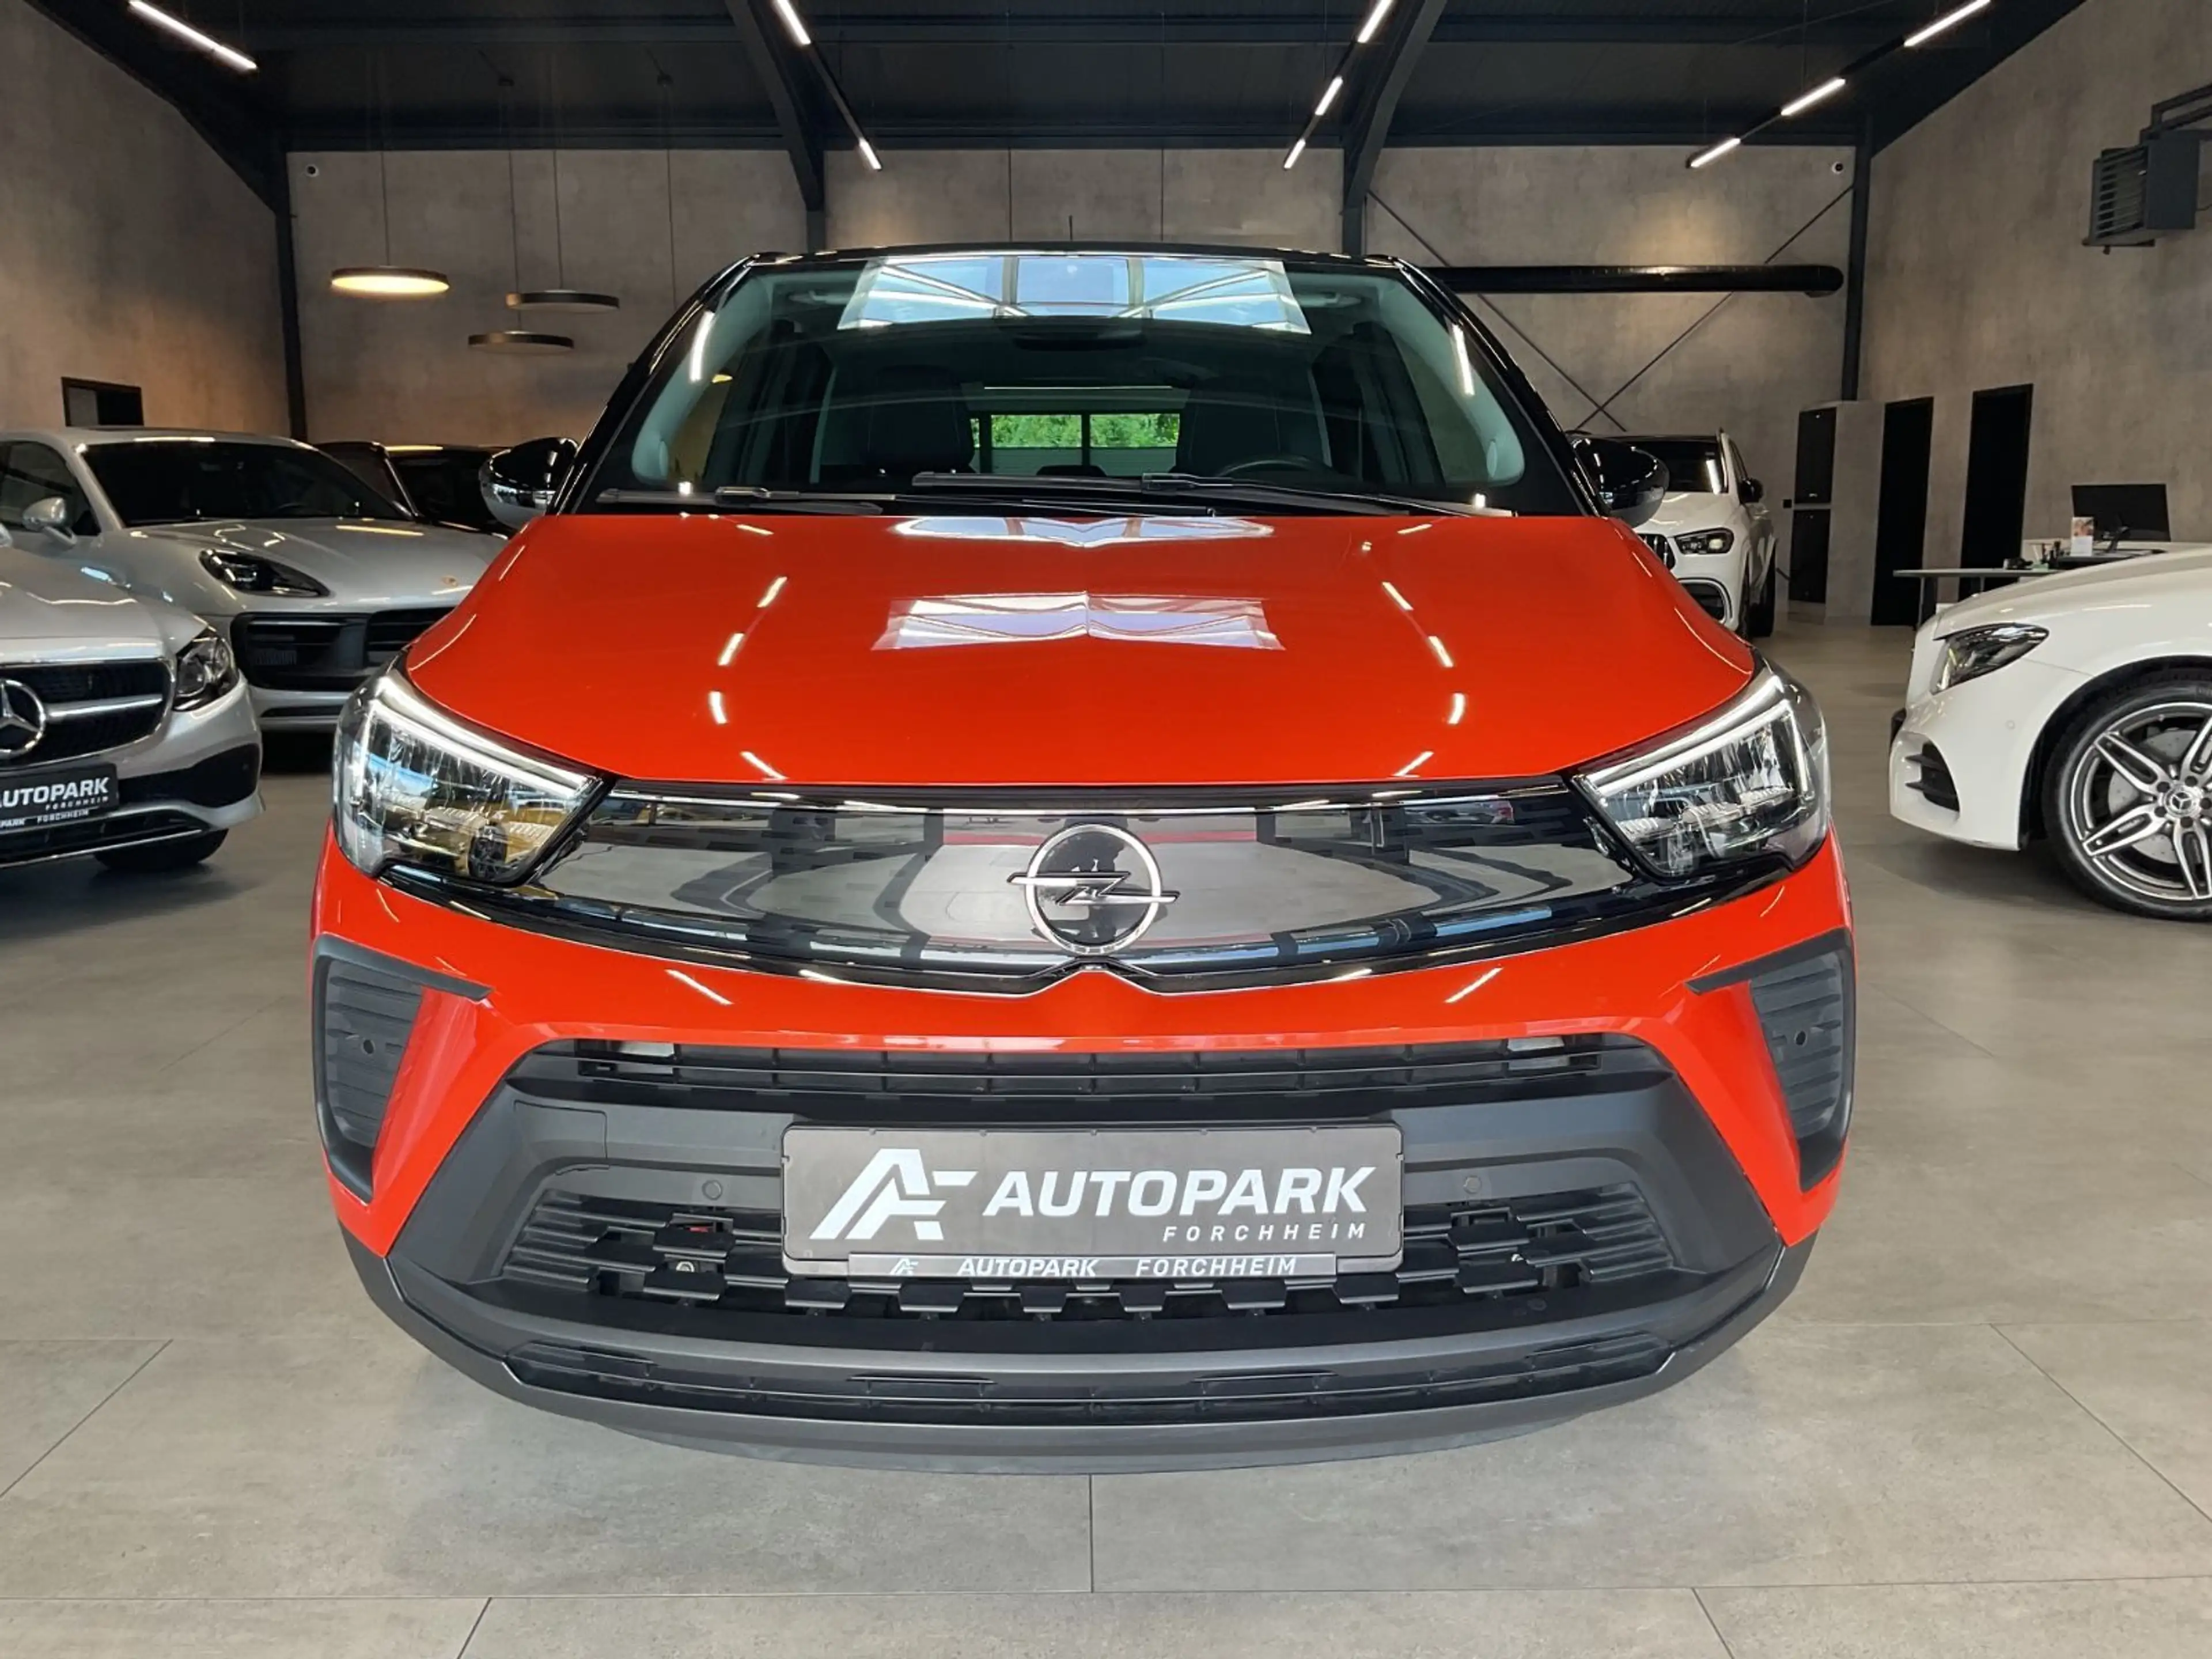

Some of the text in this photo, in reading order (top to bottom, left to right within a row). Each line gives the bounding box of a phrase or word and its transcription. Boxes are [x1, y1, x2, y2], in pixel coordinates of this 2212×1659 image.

[0, 777, 109, 808] UTOPARK
[46, 796, 108, 810] FORCHHEIM
[37, 809, 89, 823] FORCHHEIM
[982, 1166, 1376, 1217] AUTOPARK
[1163, 1224, 1366, 1242] FORCHHEIM
[957, 1258, 1097, 1277] AUTOPARK
[1135, 1256, 1297, 1277] FORCHHEIM
